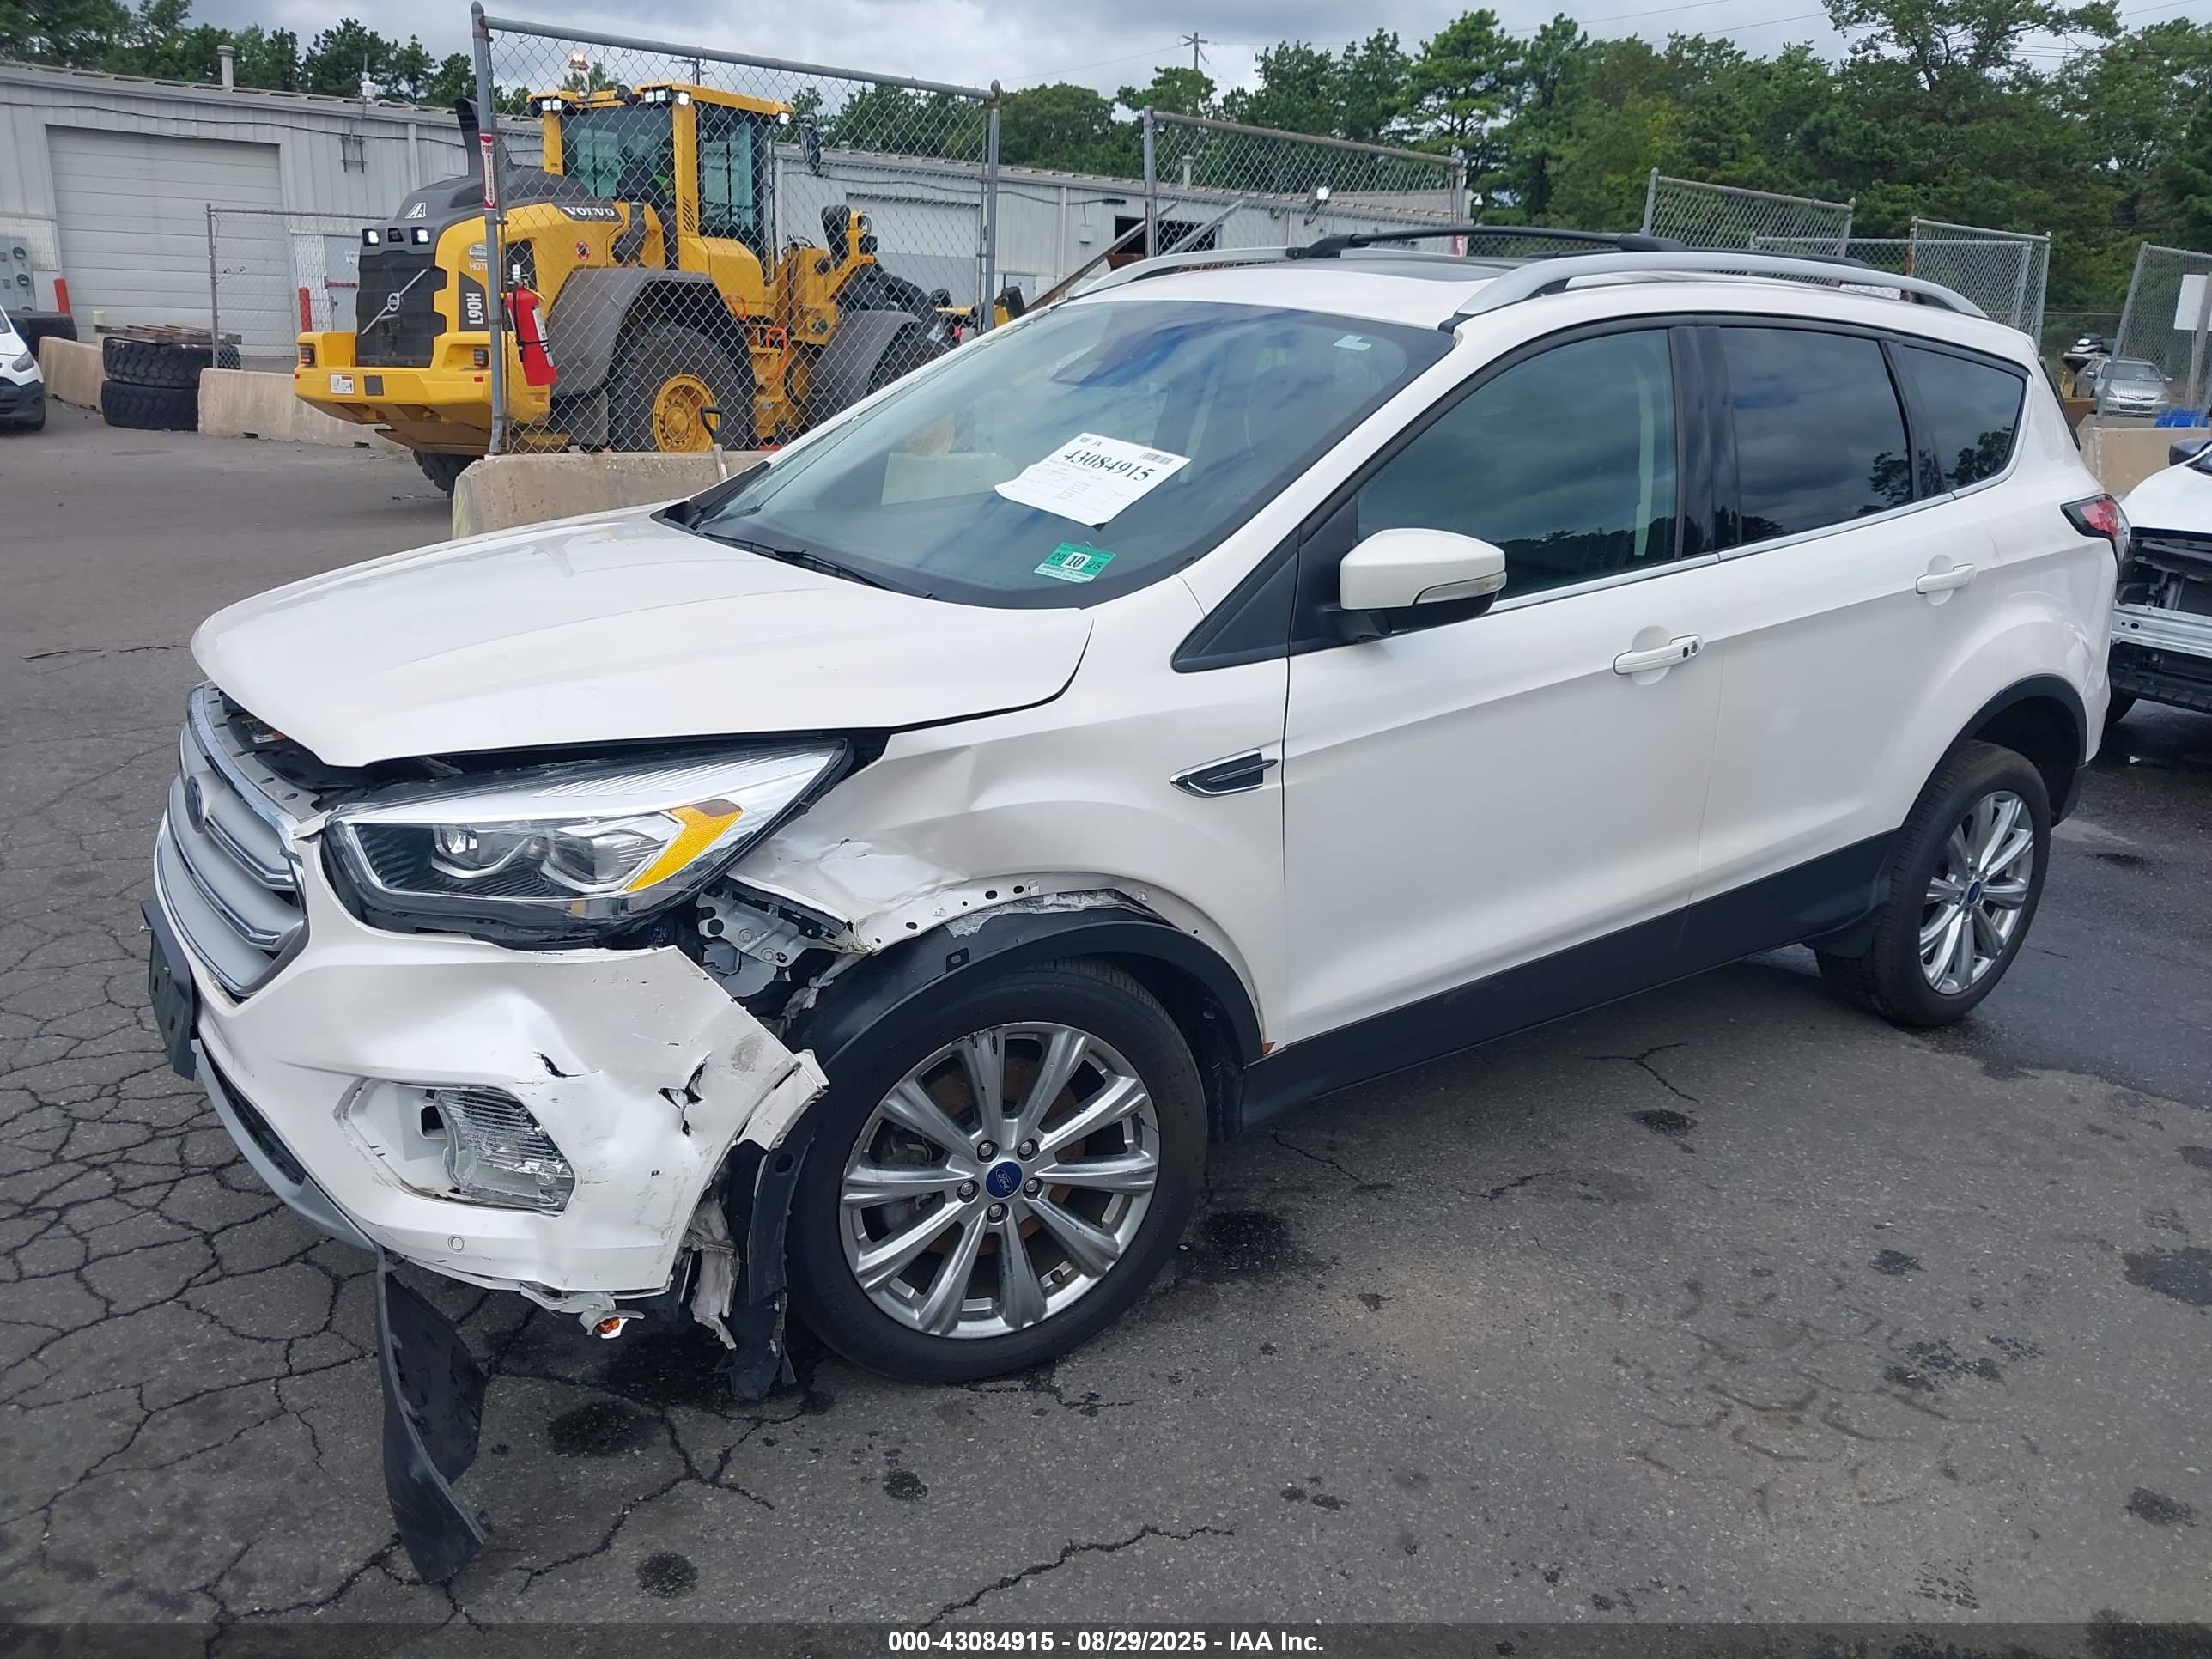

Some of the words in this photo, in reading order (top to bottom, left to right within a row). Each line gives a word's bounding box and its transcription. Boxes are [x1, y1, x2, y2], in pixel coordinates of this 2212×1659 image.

[482, 144, 493, 154] FIRE
[562, 206, 615, 216] VOLVO
[465, 293, 483, 325] L90H
[1064, 448, 1156, 482] 43084915
[1051, 552, 1066, 561] 20
[1066, 555, 1085, 568] 10
[1086, 561, 1103, 569] 25
[998, 1173, 1011, 1189] Ford
